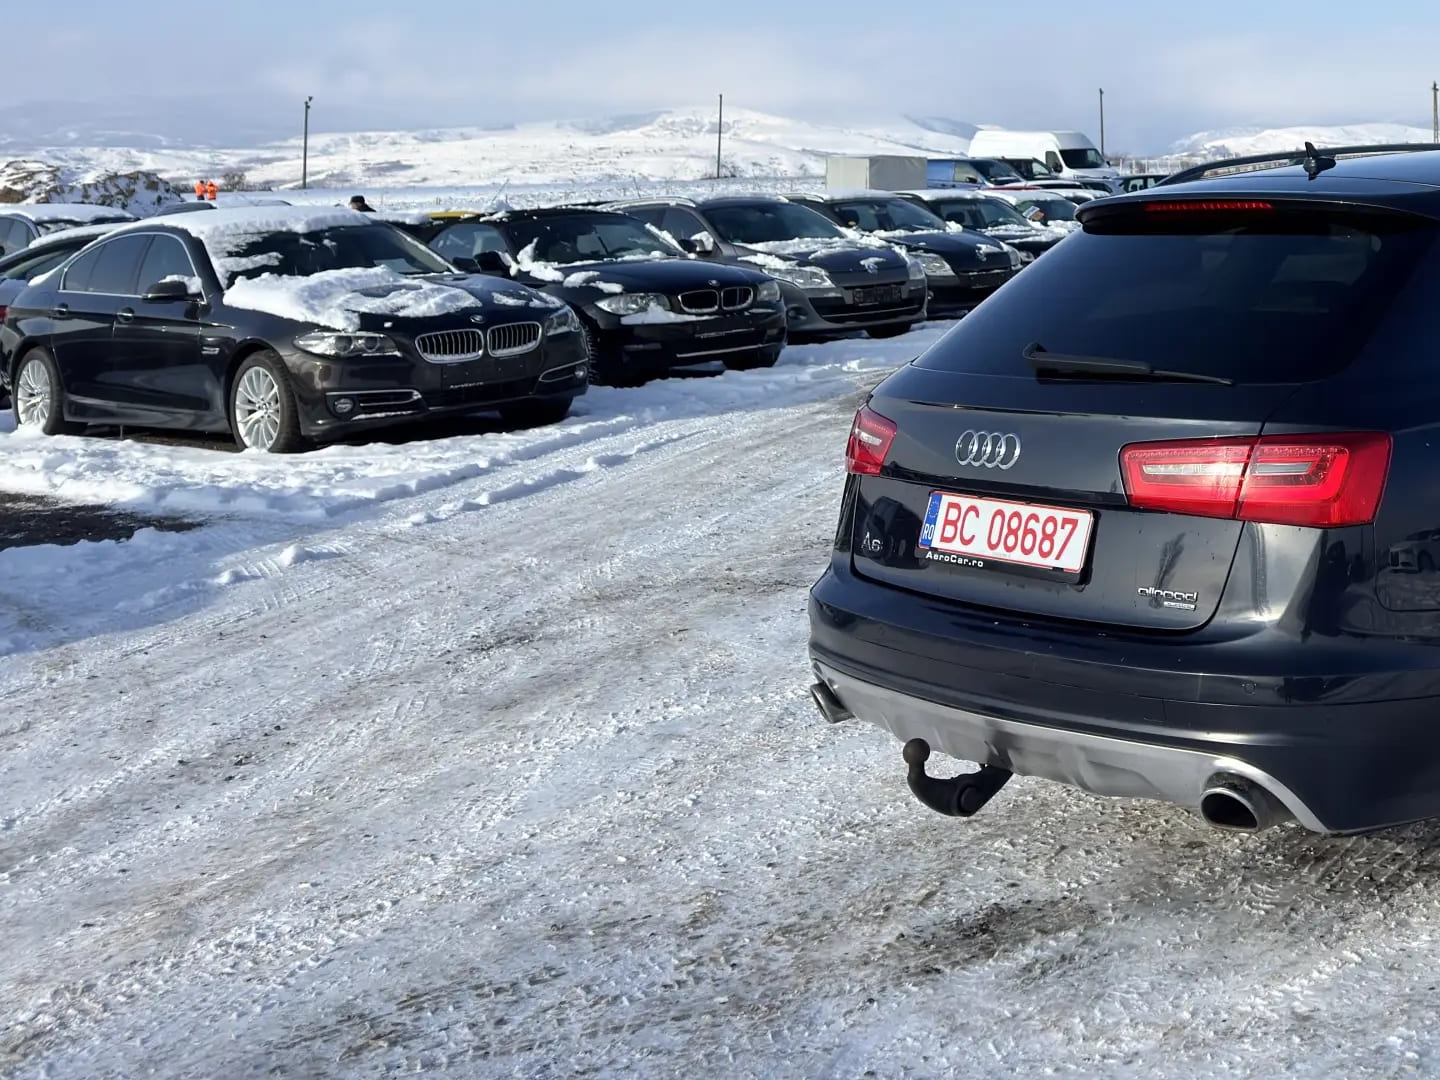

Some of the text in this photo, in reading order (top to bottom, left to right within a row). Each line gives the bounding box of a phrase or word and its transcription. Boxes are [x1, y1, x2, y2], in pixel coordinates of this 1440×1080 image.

[922, 523, 935, 540] RO
[940, 501, 1079, 561] BC 08687
[861, 531, 881, 552] A6
[925, 551, 984, 567] AeroCar.ro
